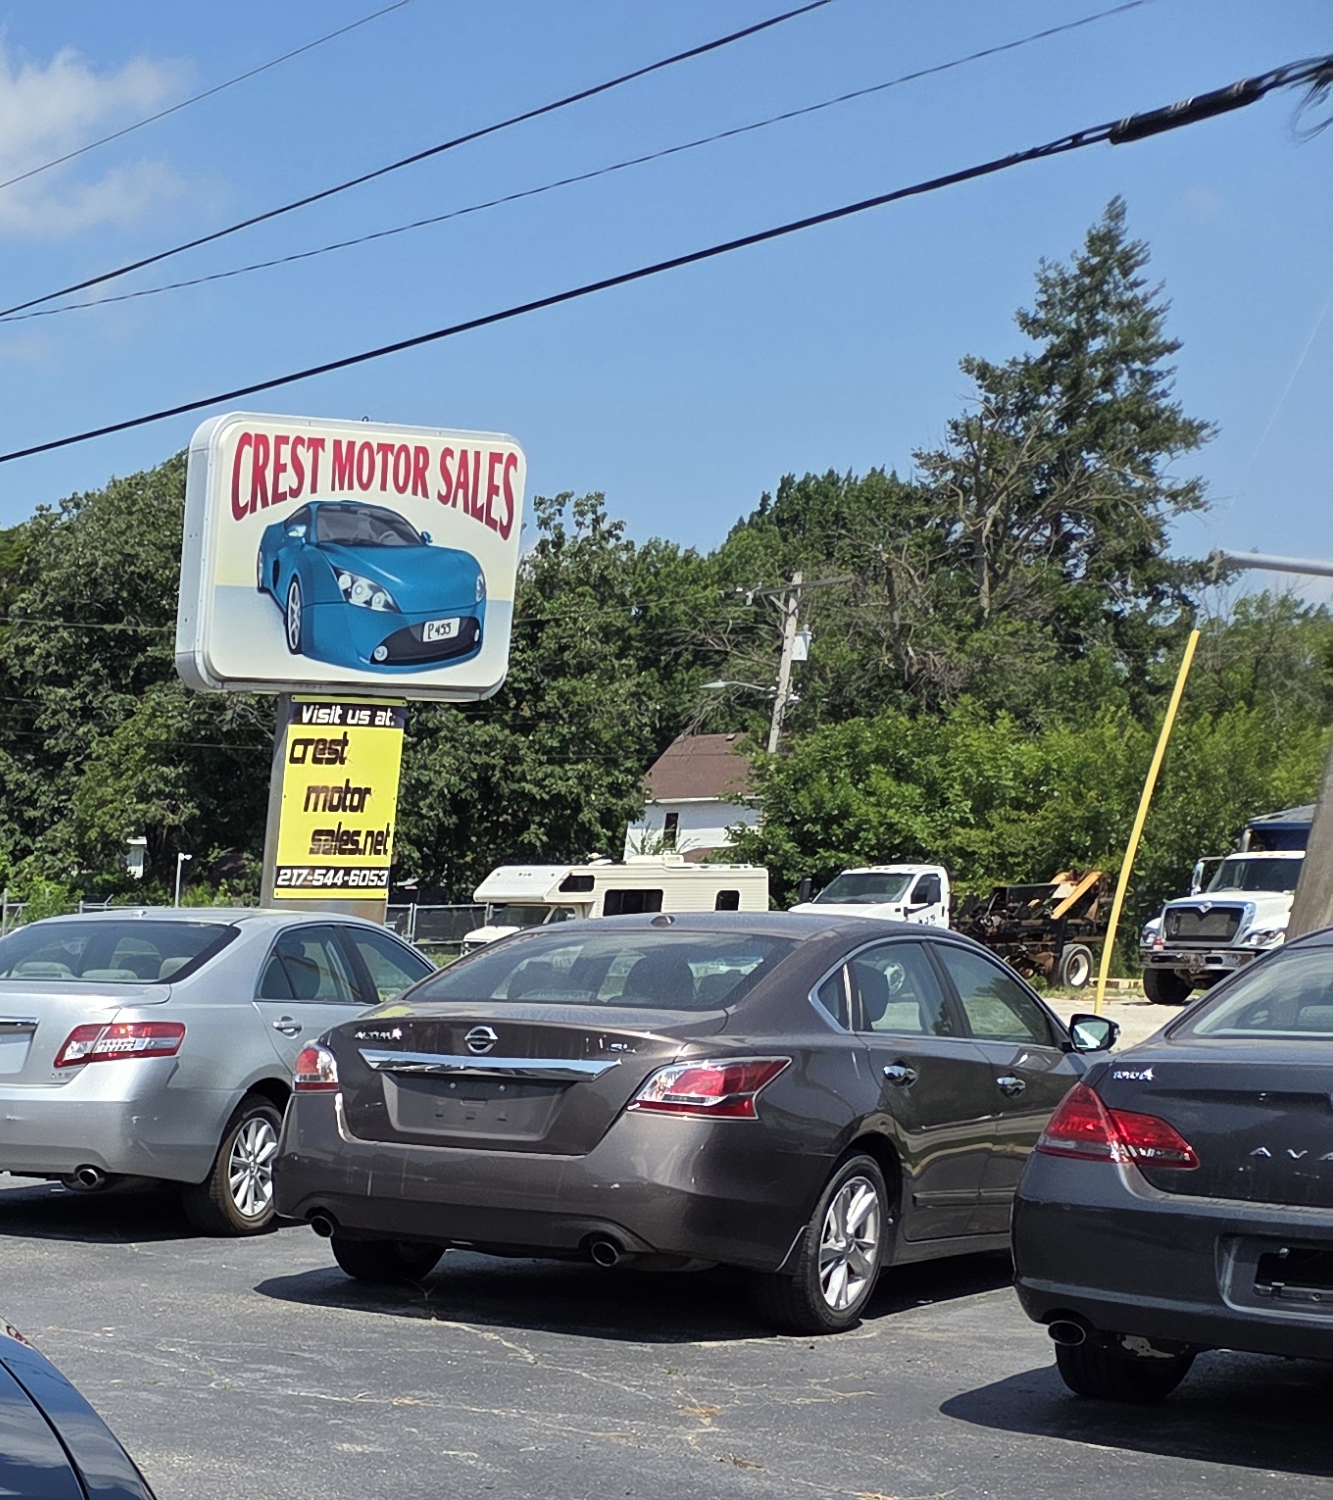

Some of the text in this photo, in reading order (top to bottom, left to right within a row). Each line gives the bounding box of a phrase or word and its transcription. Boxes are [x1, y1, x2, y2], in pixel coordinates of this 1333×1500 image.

[231, 431, 519, 541] CREST MOTOR SALES
[301, 704, 343, 725] Visit
[347, 709, 370, 725] us
[289, 731, 349, 765] crest
[303, 778, 372, 813] motor
[309, 821, 391, 856] sales.net
[276, 868, 388, 886] 217-544-6053
